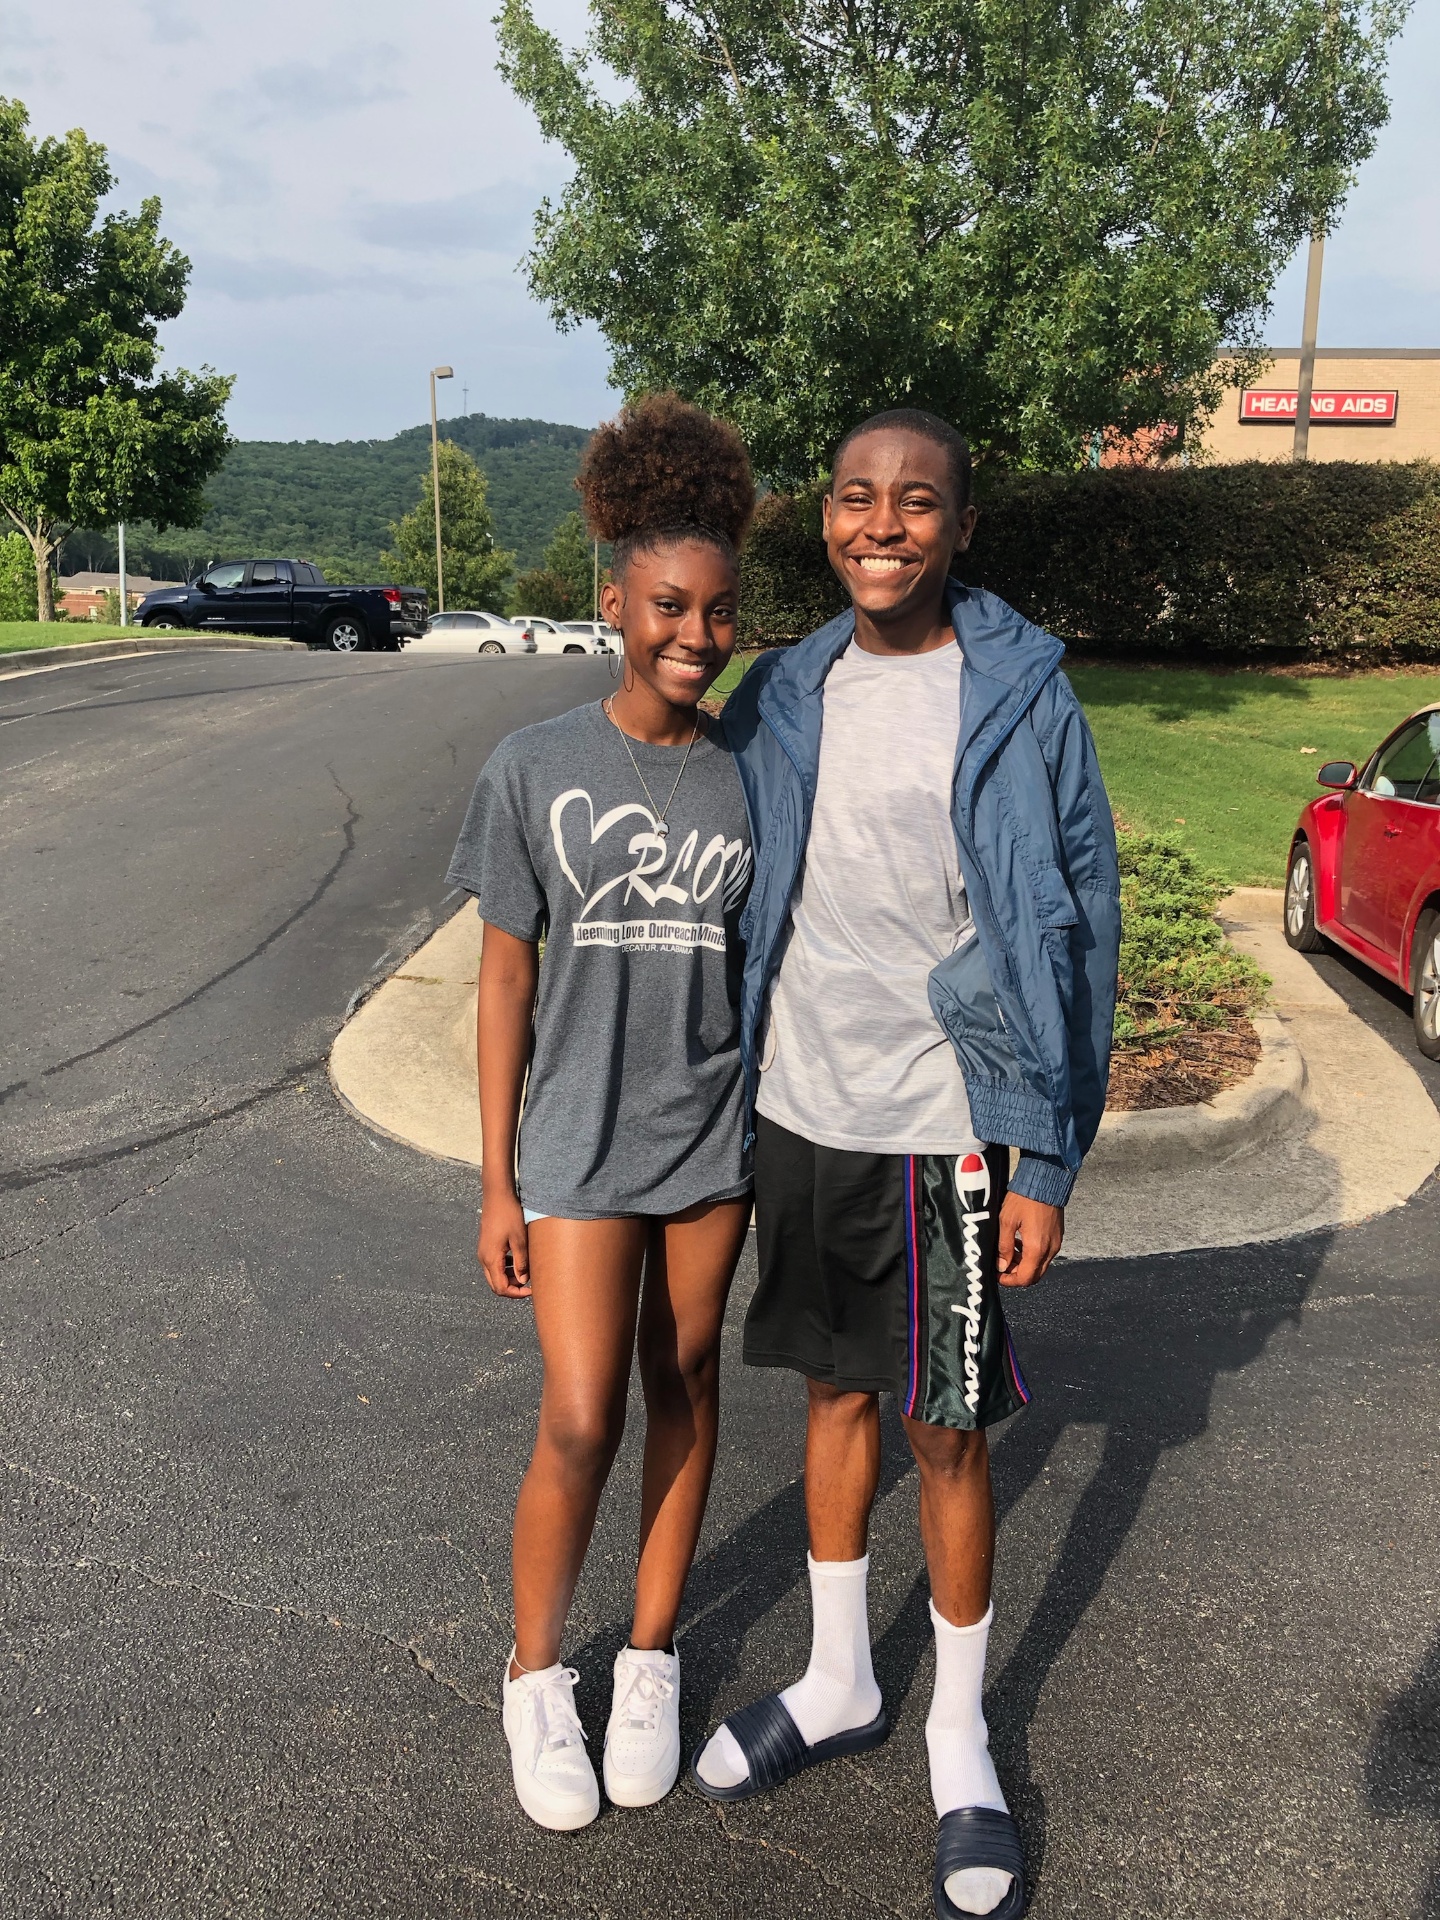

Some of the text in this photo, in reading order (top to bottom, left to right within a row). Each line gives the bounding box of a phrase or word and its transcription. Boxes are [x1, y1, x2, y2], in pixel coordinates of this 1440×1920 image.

[1251, 397, 1387, 413] HEANG AIDS
[621, 924, 645, 940] Love
[648, 922, 698, 942] Outreach
[660, 944, 694, 955] ALABAMA
[950, 1152, 991, 1414] Champion
